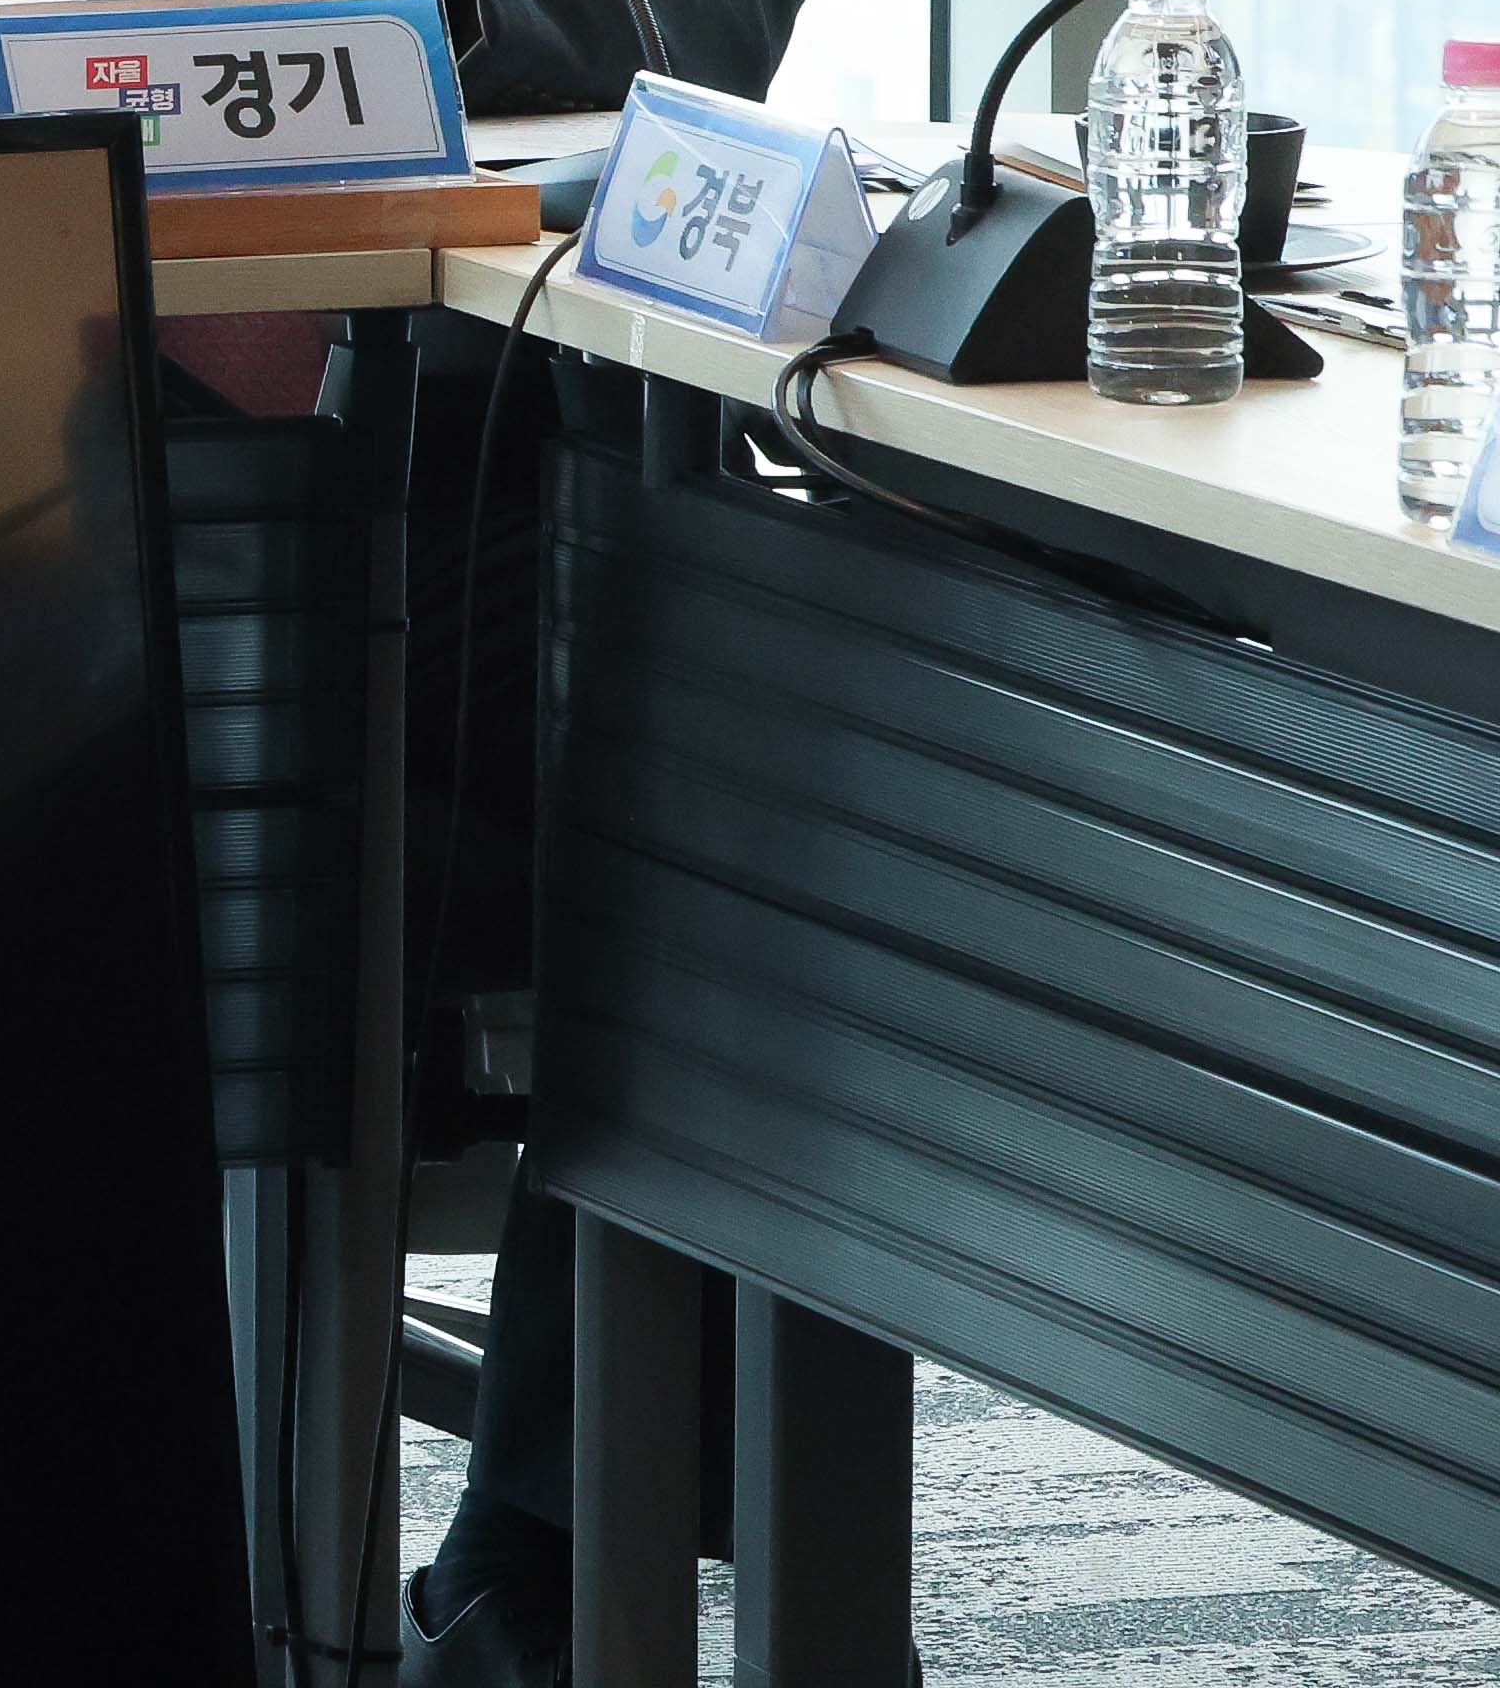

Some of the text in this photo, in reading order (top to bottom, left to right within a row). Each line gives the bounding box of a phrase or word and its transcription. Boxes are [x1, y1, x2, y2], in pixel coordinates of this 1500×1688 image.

[92, 60, 141, 84] 자율
[125, 87, 175, 113] 균형
[192, 46, 365, 139] 경기
[678, 163, 765, 273] 경북
